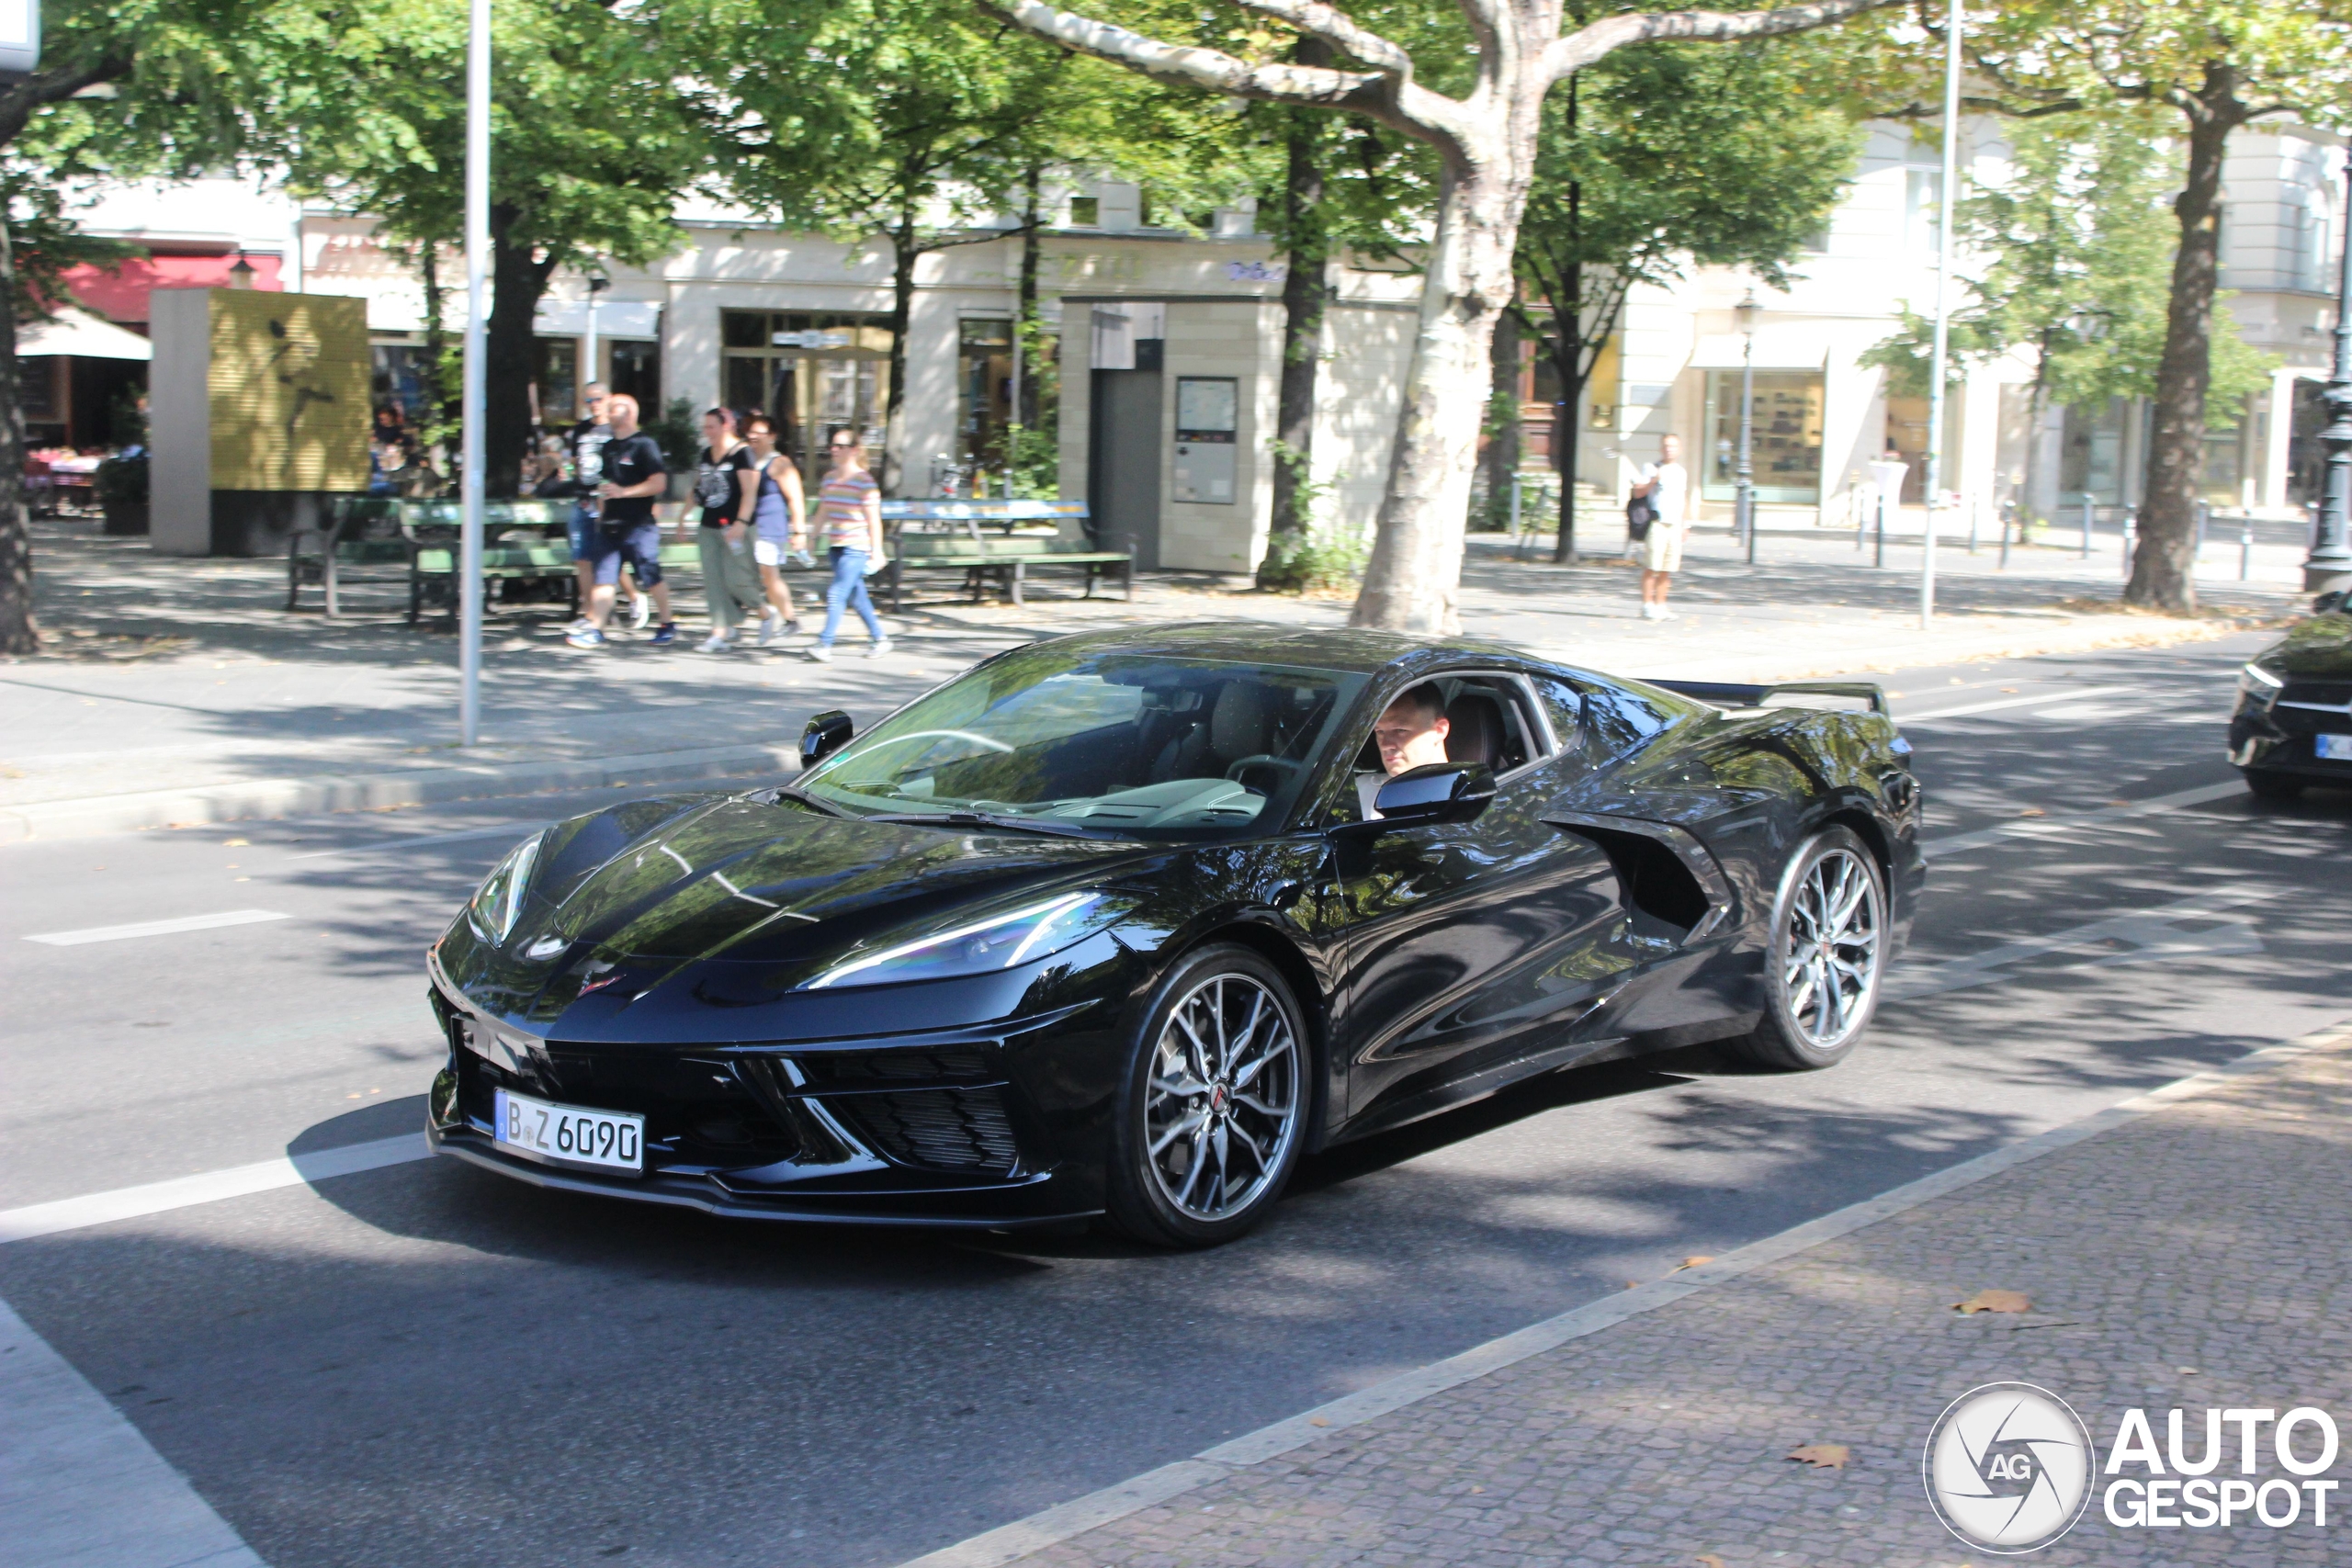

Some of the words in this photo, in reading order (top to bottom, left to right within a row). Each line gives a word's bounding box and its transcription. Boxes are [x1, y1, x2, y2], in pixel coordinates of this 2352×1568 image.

[499, 1122, 504, 1134] D
[509, 1101, 521, 1140] B
[558, 1115, 637, 1161] 6090
